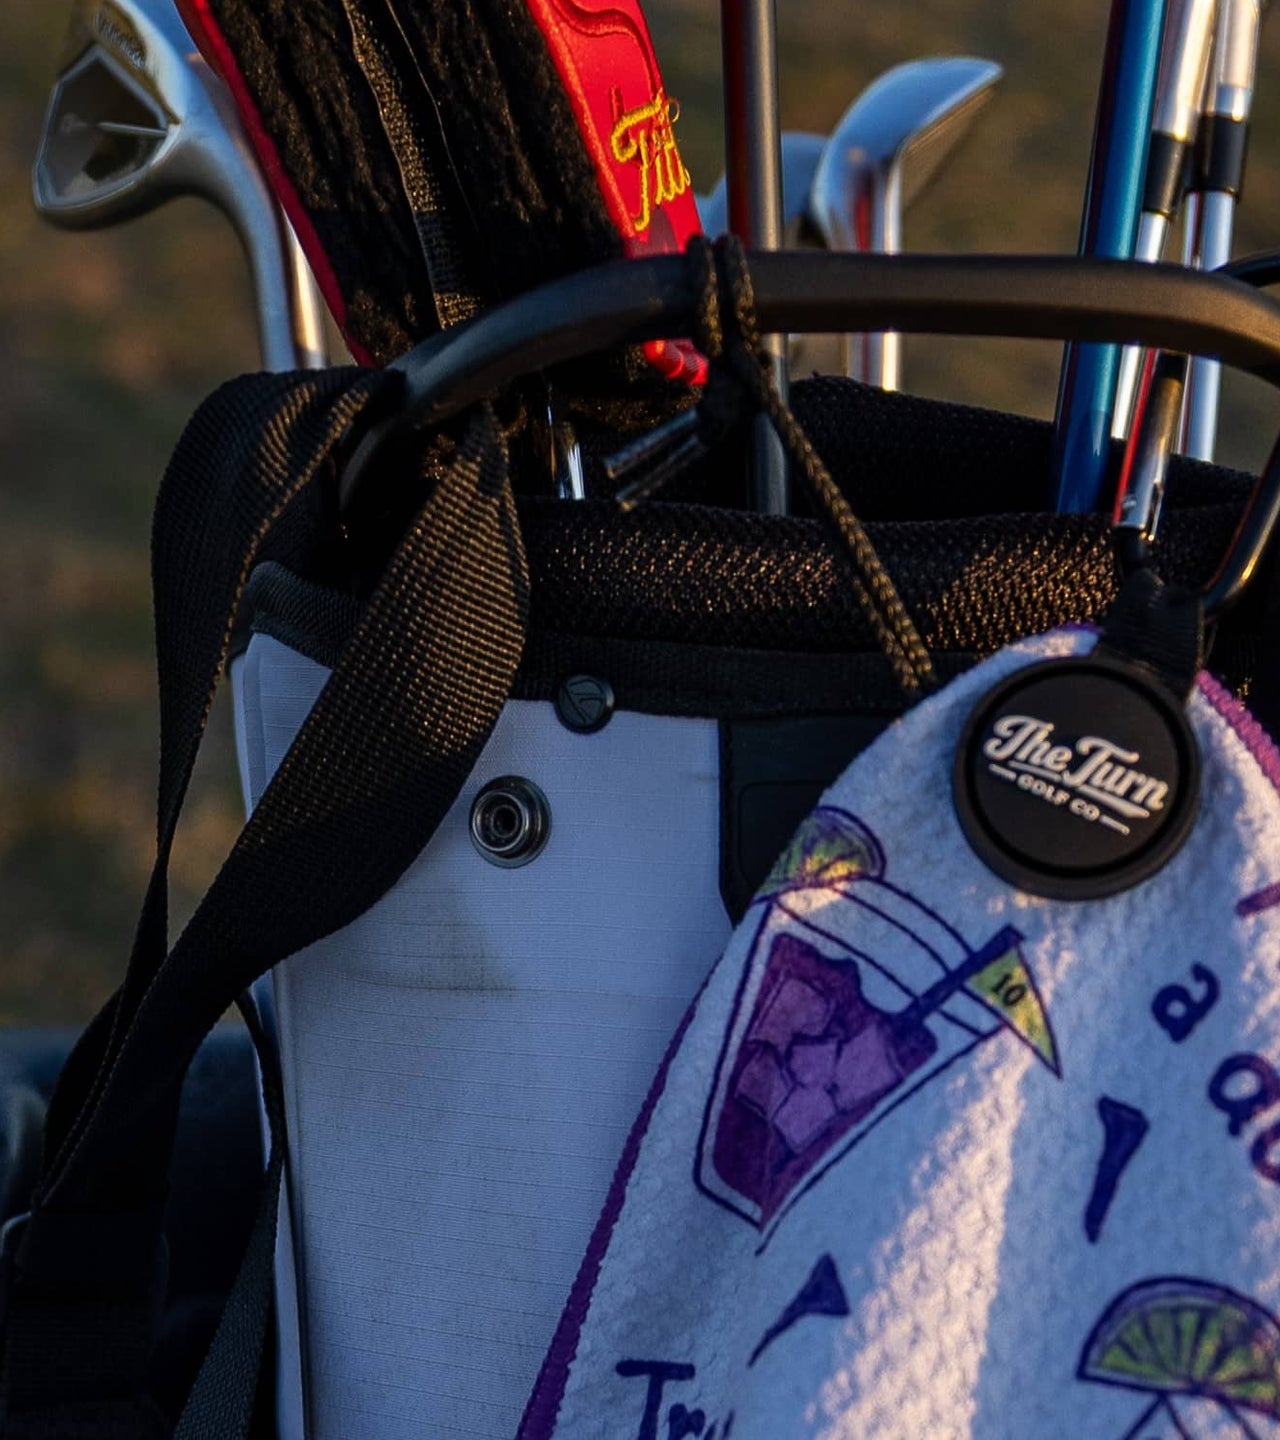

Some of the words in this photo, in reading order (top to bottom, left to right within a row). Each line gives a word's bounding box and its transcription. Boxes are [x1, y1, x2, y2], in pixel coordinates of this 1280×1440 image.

[983, 714, 1072, 771] The
[1063, 735, 1169, 810] Turn
[1017, 773, 1070, 807] GOLF
[991, 972, 1027, 1007] 10
[1150, 962, 1220, 1043] a
